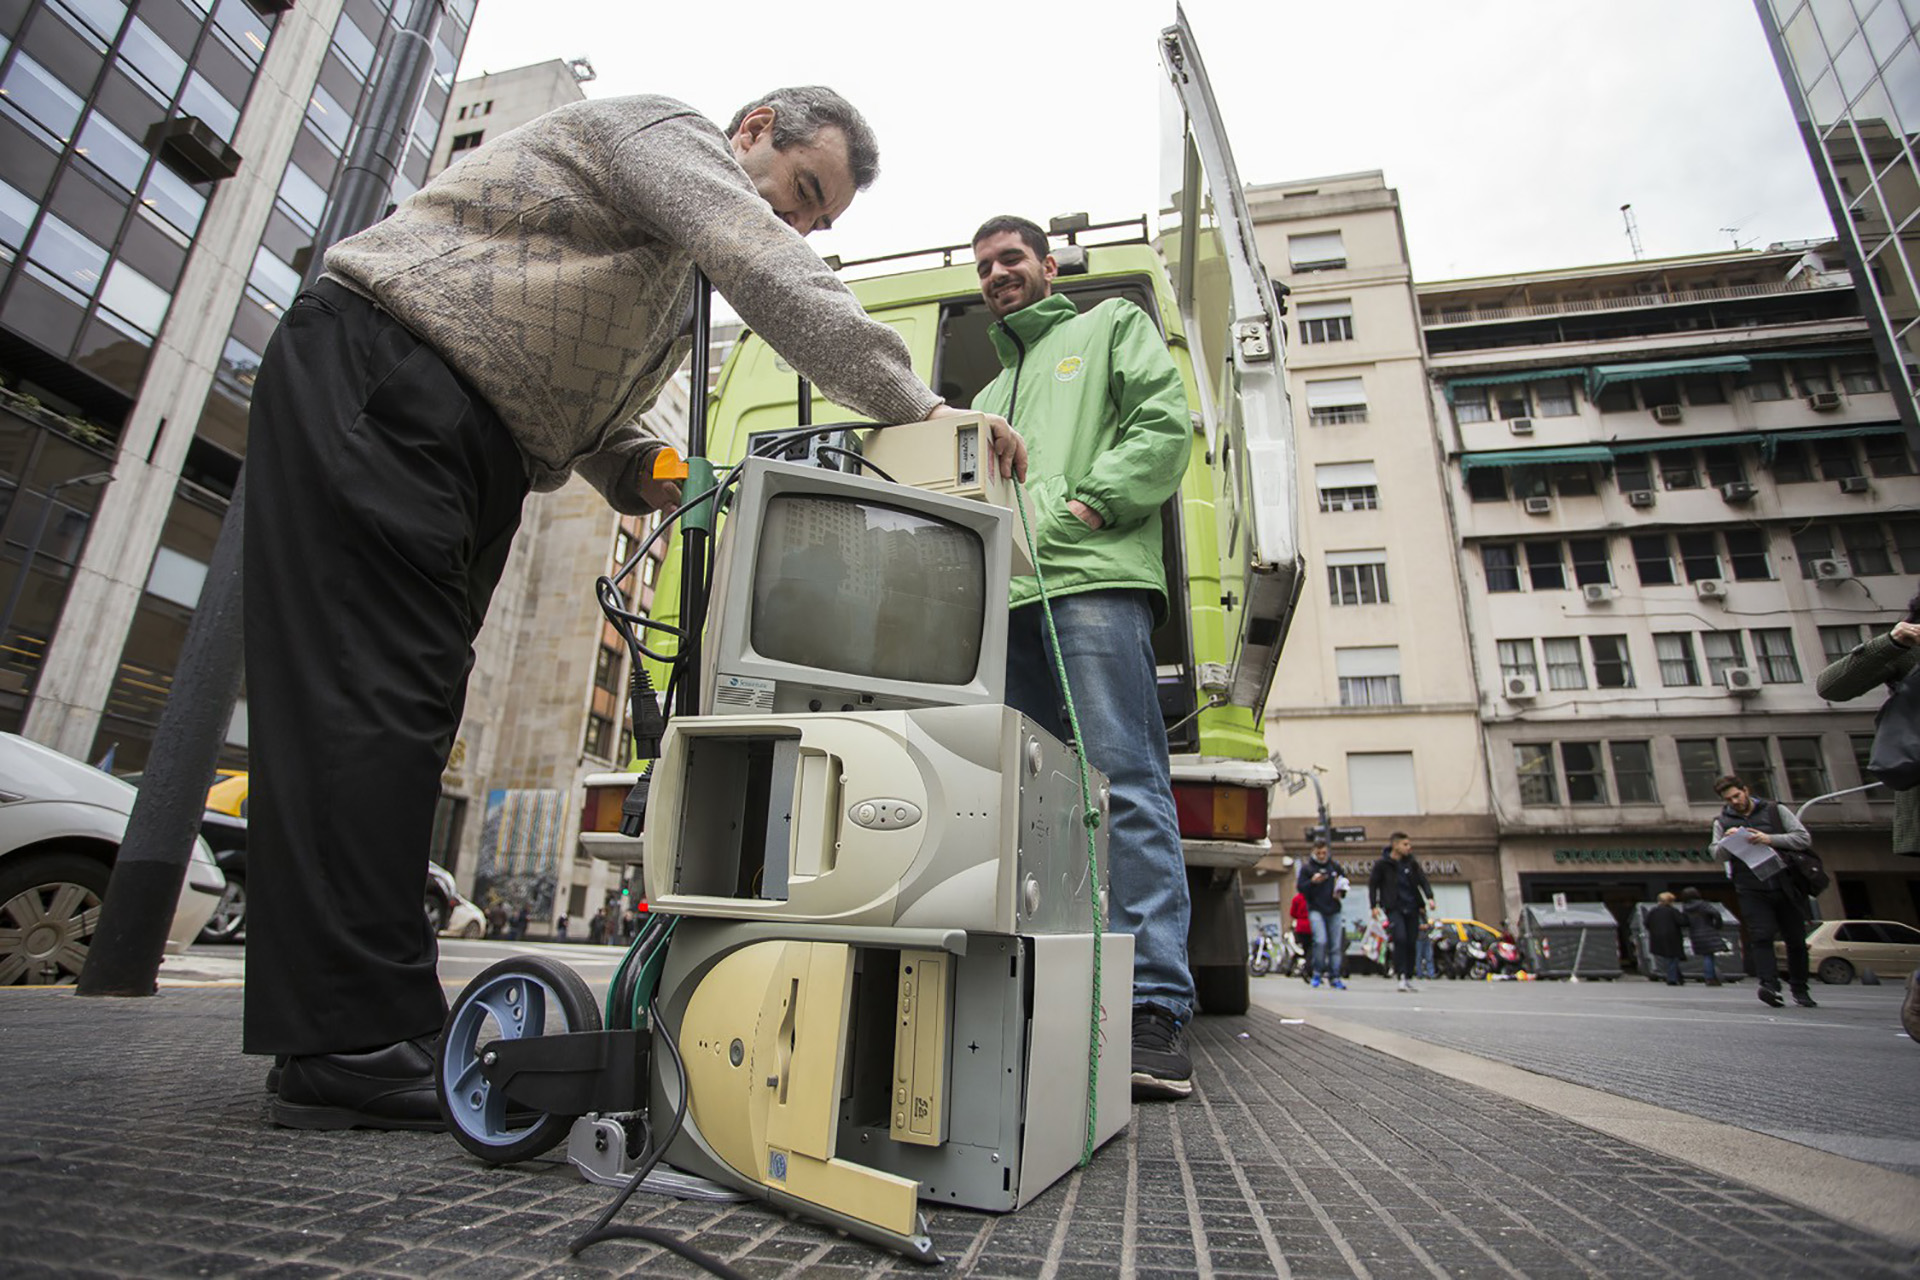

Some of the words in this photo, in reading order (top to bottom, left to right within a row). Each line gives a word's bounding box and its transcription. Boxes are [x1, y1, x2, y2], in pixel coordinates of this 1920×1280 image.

[1553, 849, 1681, 864] STARBUCKS
[1685, 849, 1715, 863] CO
[1420, 859, 1462, 875] ONIA
